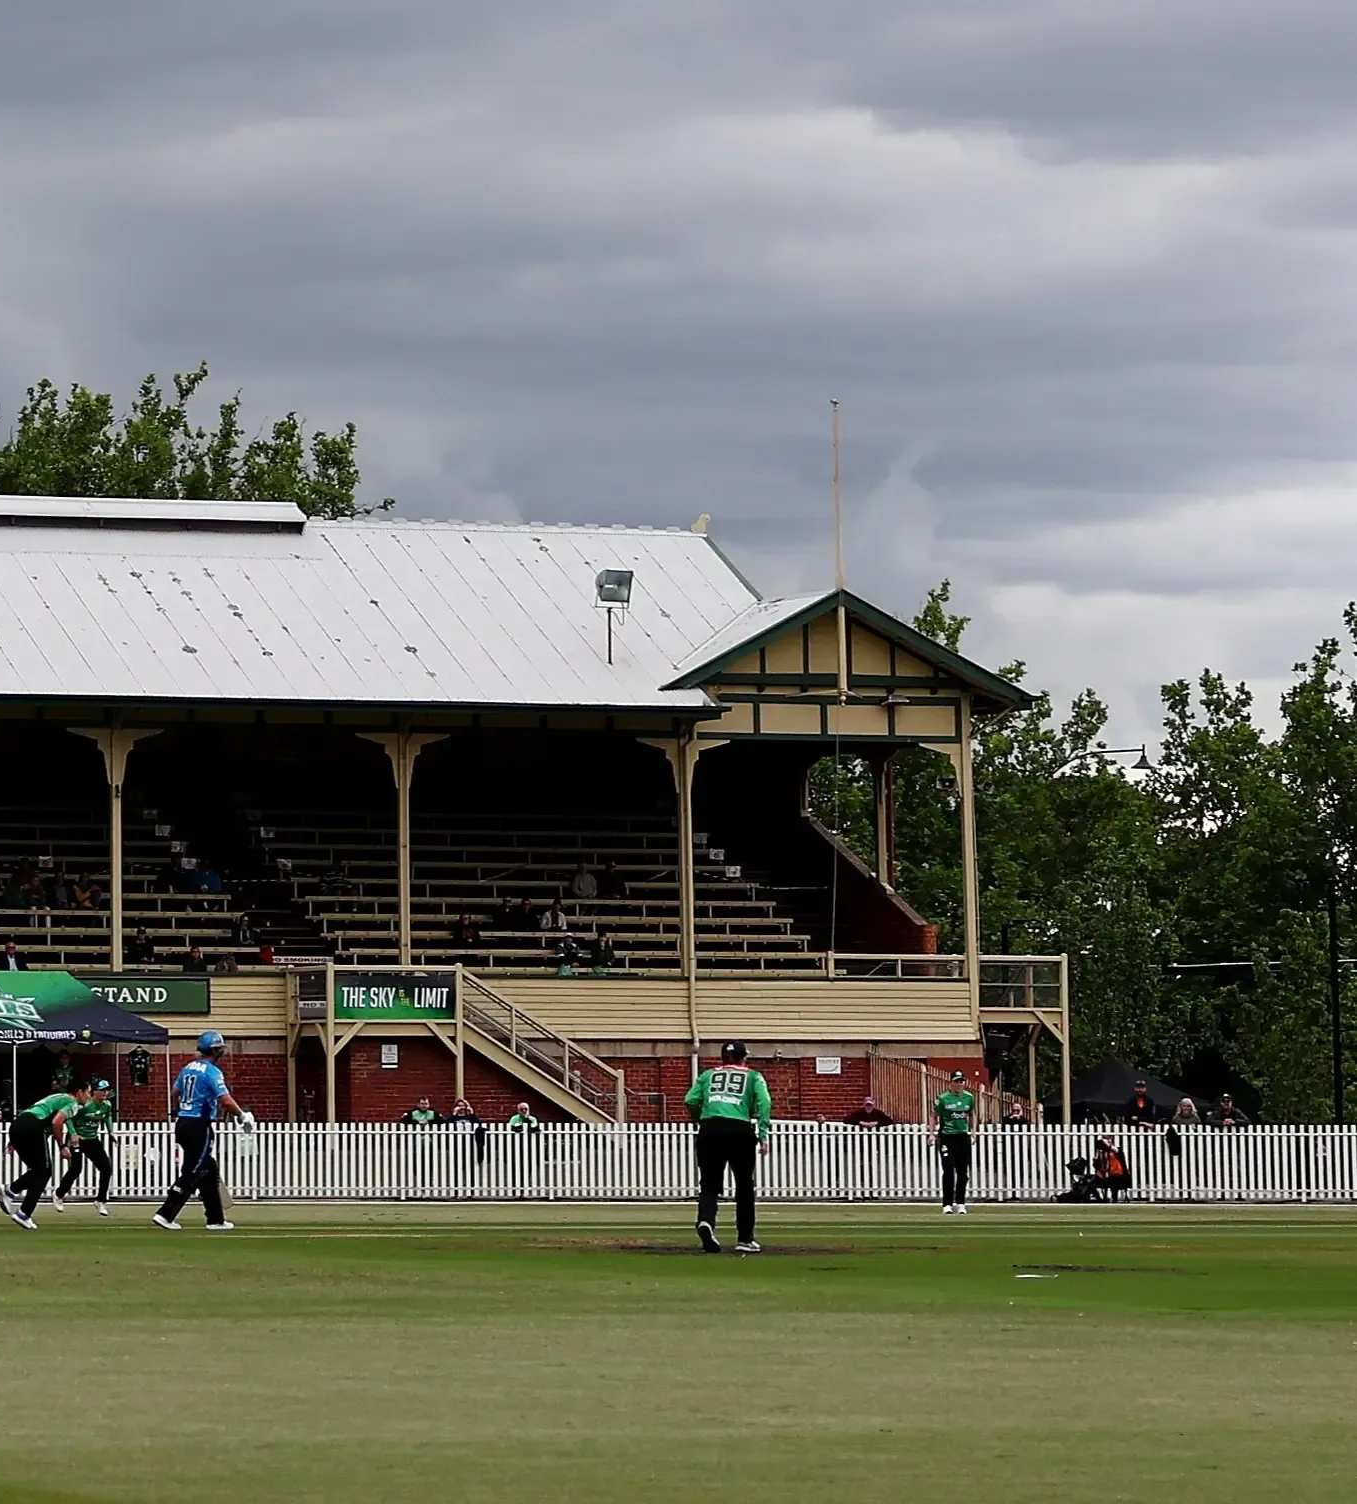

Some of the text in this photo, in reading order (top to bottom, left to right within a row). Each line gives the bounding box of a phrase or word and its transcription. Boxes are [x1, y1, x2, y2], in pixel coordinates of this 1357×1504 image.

[341, 986, 367, 1008] THE
[369, 986, 397, 1008] SKY
[413, 987, 450, 1009] LIMIT
[182, 1073, 198, 1104] 11
[709, 1070, 748, 1097] 99
